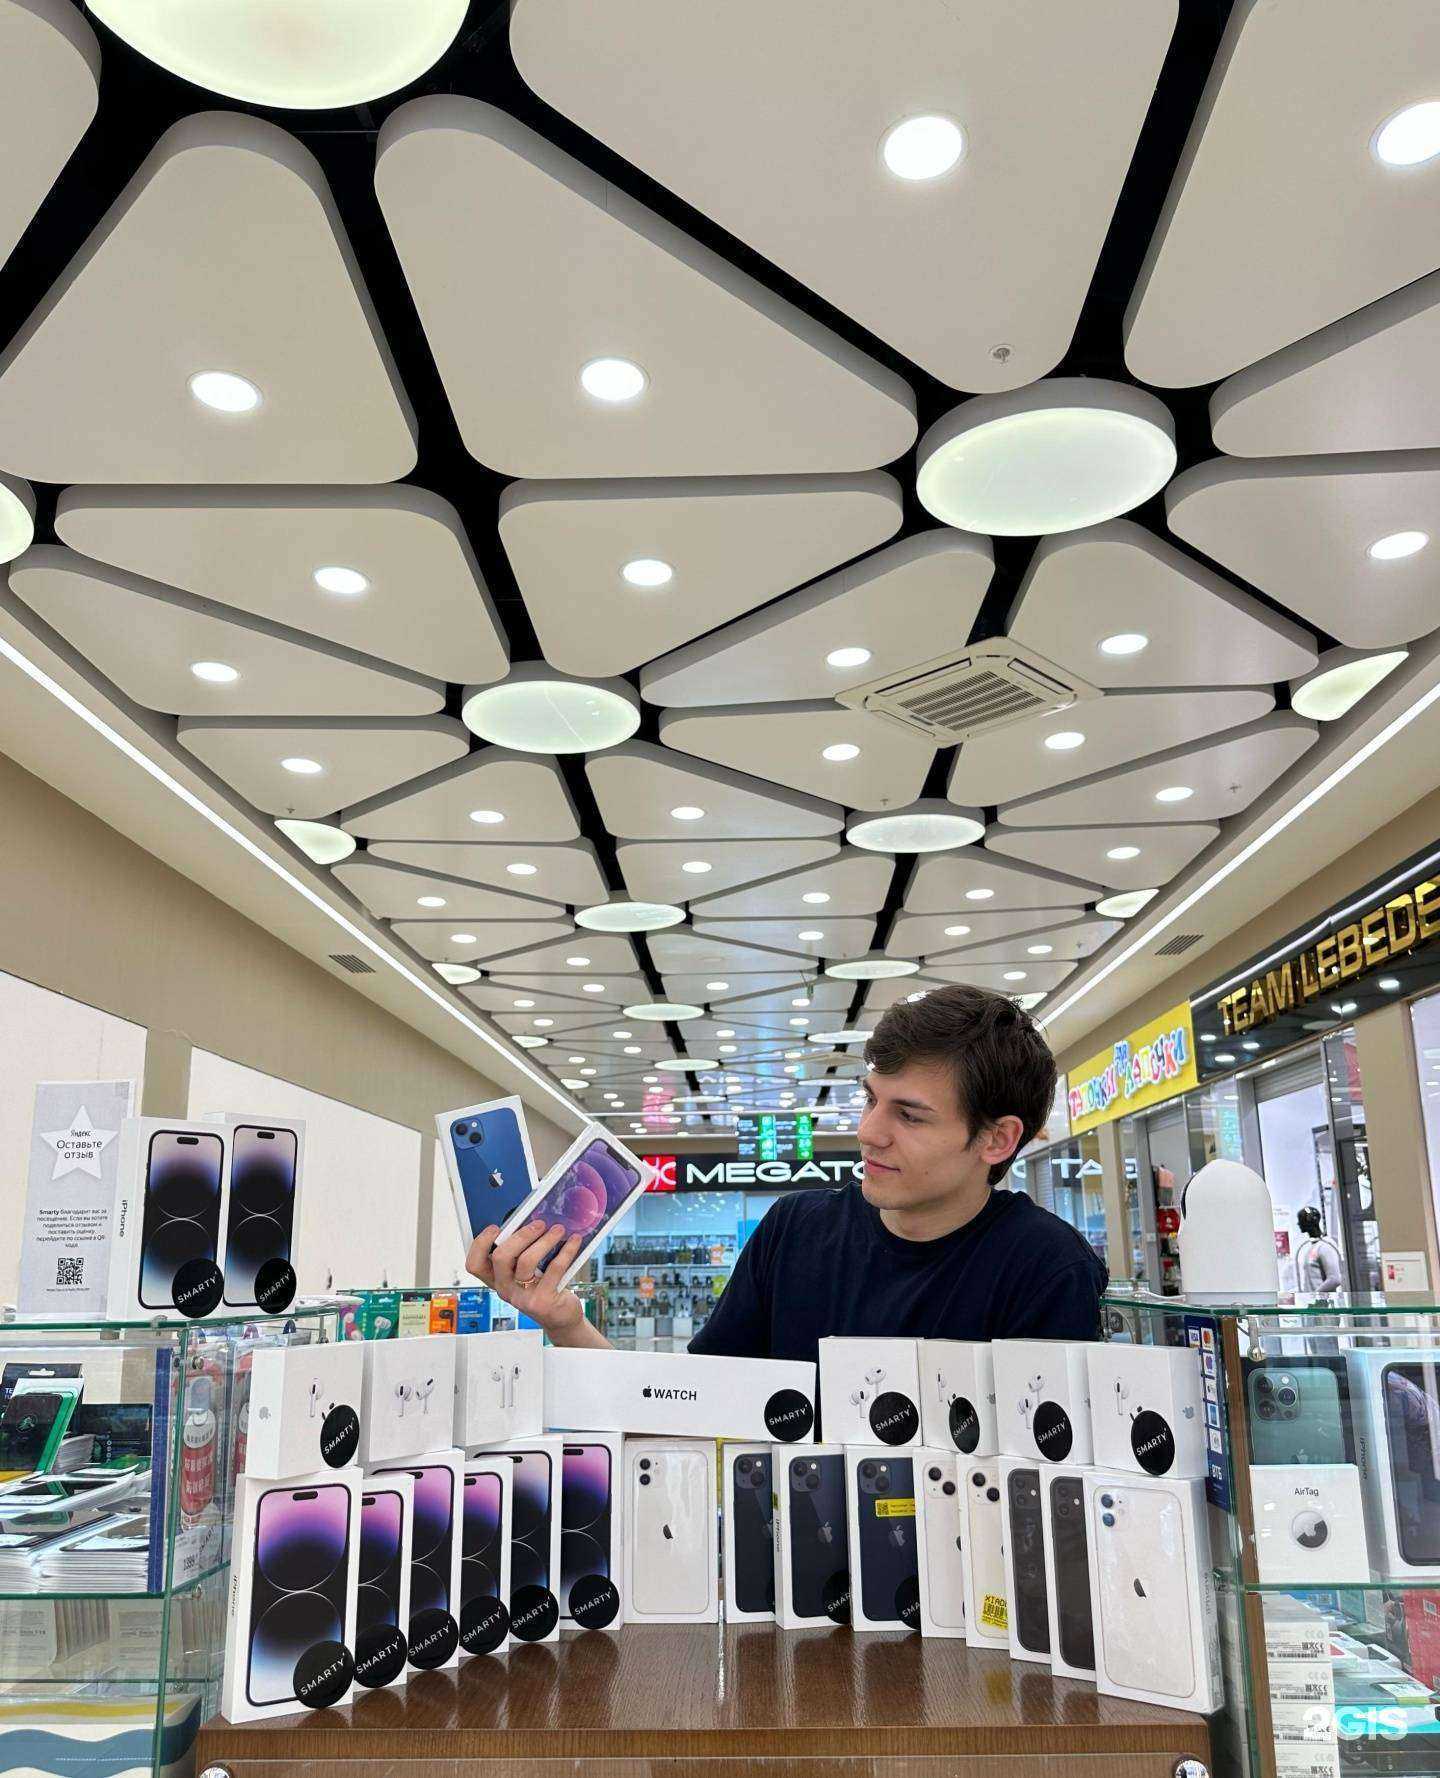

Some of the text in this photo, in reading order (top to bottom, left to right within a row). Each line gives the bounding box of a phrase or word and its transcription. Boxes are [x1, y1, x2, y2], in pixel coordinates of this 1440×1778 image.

[1217, 961, 1294, 1036] TEAM
[56, 1140, 102, 1149] Оставьте
[64, 1151, 94, 1159] отзыв
[120, 1199, 128, 1237] iPhone
[177, 1275, 217, 1304] SMARTY
[259, 1273, 290, 1303] SMARTY
[653, 1388, 697, 1401] WATCH
[769, 1406, 806, 1427] SMARTY
[875, 1408, 911, 1432] SMARTY
[324, 1421, 354, 1455] SMARTY
[1037, 1421, 1067, 1444] SMARTY
[1136, 1432, 1167, 1456] SMARTY
[1294, 1487, 1319, 1497] AirTag
[511, 1601, 551, 1630] SMARTY
[574, 1591, 612, 1616] SMARTY
[462, 1611, 501, 1643] SMARTY
[408, 1626, 451, 1658] SMARTY
[356, 1640, 400, 1675] SMARTY
[300, 1656, 345, 1696] SMARTY
